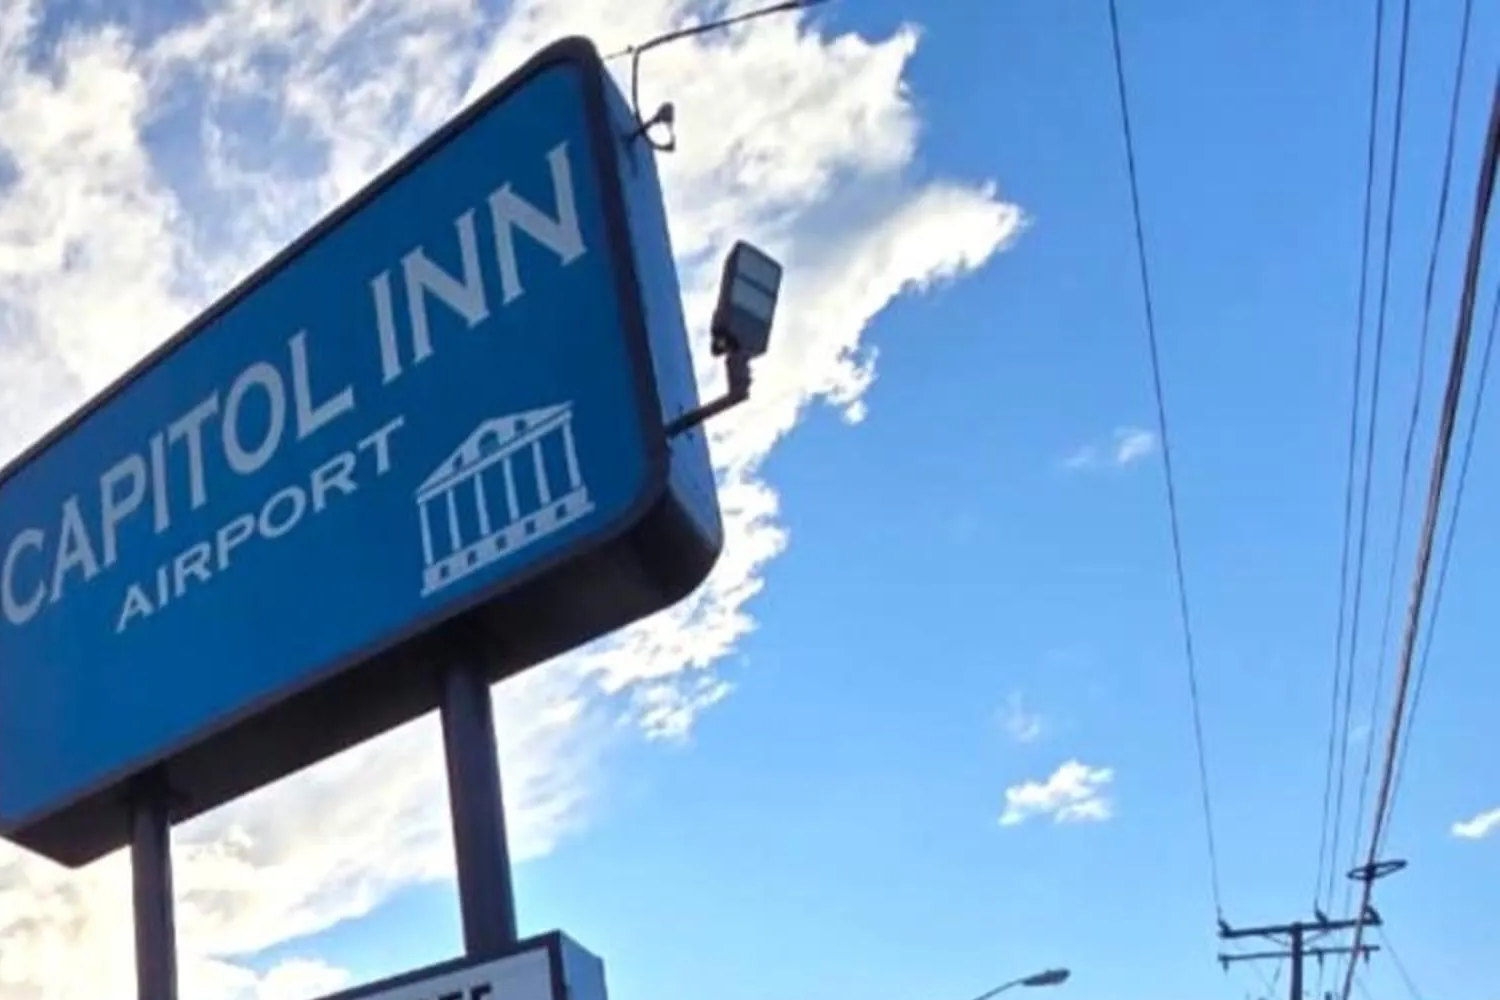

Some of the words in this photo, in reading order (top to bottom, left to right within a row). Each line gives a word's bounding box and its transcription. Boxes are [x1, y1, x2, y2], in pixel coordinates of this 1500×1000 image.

[0, 328, 354, 625] CAPITOL
[369, 140, 588, 385] INN
[114, 414, 404, 634] AIRPORT
